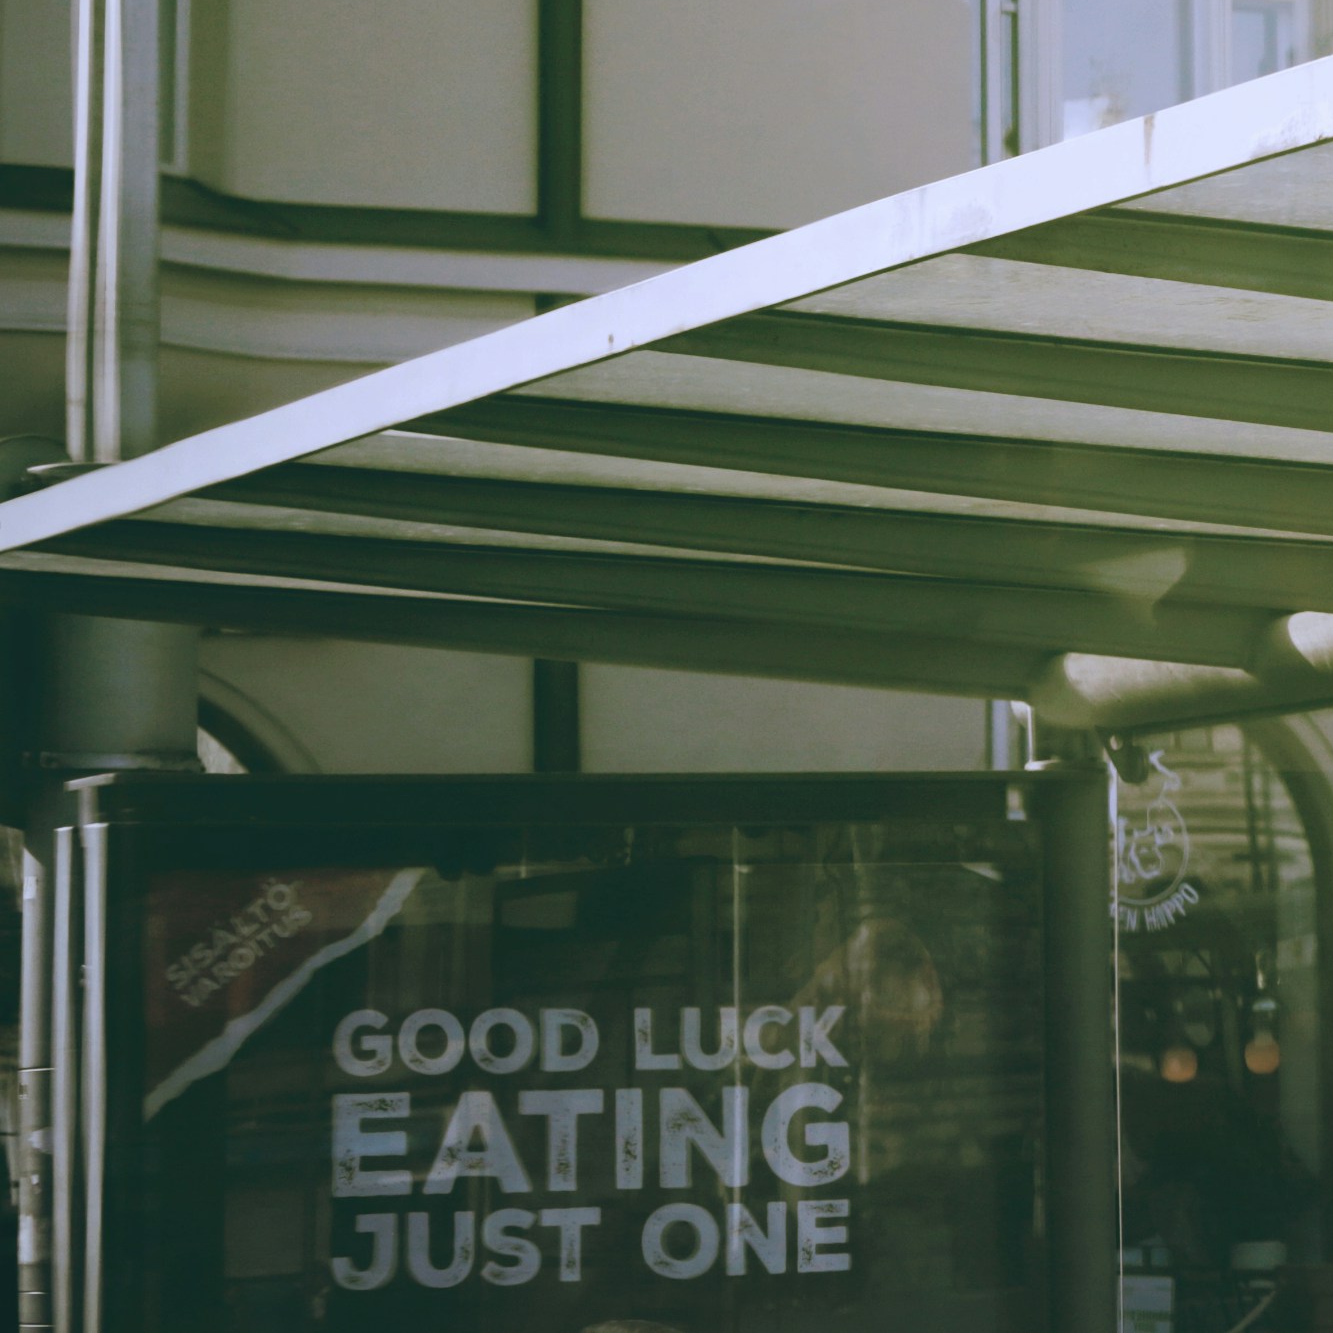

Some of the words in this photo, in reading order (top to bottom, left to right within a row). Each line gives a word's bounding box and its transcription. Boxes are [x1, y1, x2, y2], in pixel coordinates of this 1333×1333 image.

[332, 1008, 599, 1077] GOOD
[634, 1005, 849, 1070] LUCK
[331, 1082, 851, 1197] EATING
[331, 1207, 600, 1291] JUST
[641, 1199, 851, 1280] ONE
